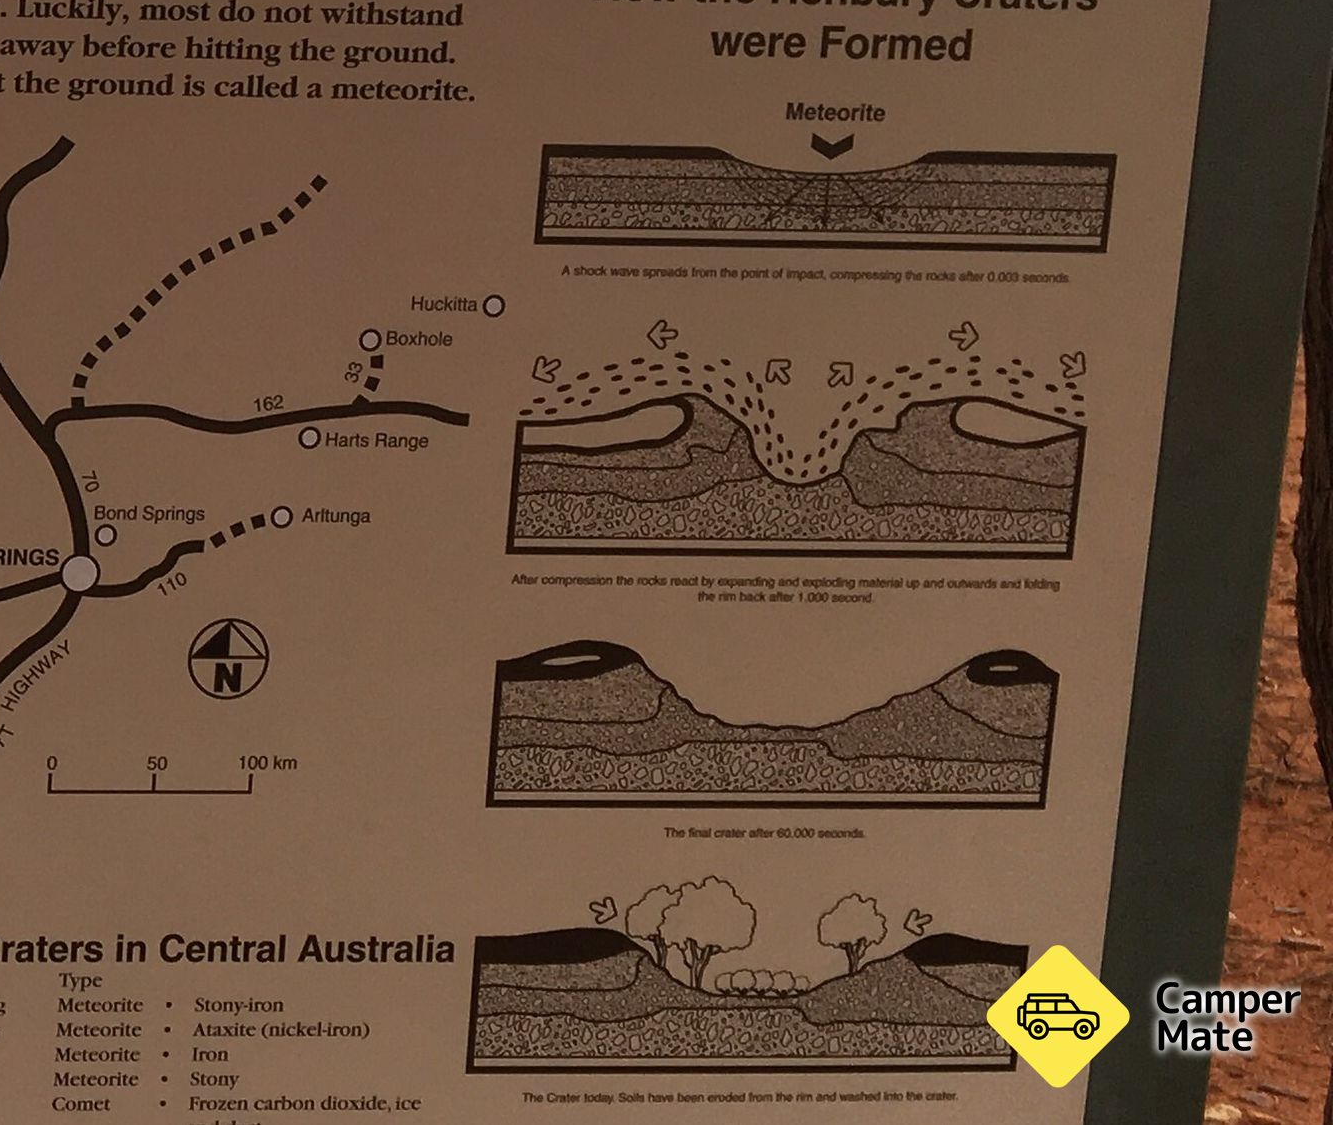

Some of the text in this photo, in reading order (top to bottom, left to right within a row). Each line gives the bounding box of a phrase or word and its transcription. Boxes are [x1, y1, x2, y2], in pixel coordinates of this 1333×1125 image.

[711, 26, 973, 61] were Formed
[786, 102, 885, 121] Meteorite
[411, 296, 478, 312] Huckitta
[386, 331, 453, 347] Boxhole
[344, 361, 363, 383] 33
[253, 395, 284, 412] 162
[326, 433, 428, 451] Harts Range
[81, 470, 100, 493] 70
[94, 505, 205, 524] Bond Springs
[302, 508, 370, 527] Arltunga
[157, 572, 187, 596] 110
[0, 639, 73, 712] HIGHWAY
[214, 663, 242, 692] N
[47, 756, 57, 770] 0
[146, 756, 167, 771] 50
[239, 756, 297, 771] 100 km
[116, 934, 146, 962] in
[160, 934, 286, 963] Central
[298, 935, 454, 962] Australia
[59, 973, 102, 992] Type
[58, 998, 143, 1012] Meteorite
[195, 998, 283, 1016] Stony-iron
[57, 1023, 141, 1037] Meteorite
[193, 1022, 369, 1039] Ataxite (nickel-iron)
[55, 1048, 140, 1062] Meteorite
[193, 1047, 228, 1061] Iron
[54, 1072, 138, 1086] Meteorite
[190, 1072, 239, 1090] Stony
